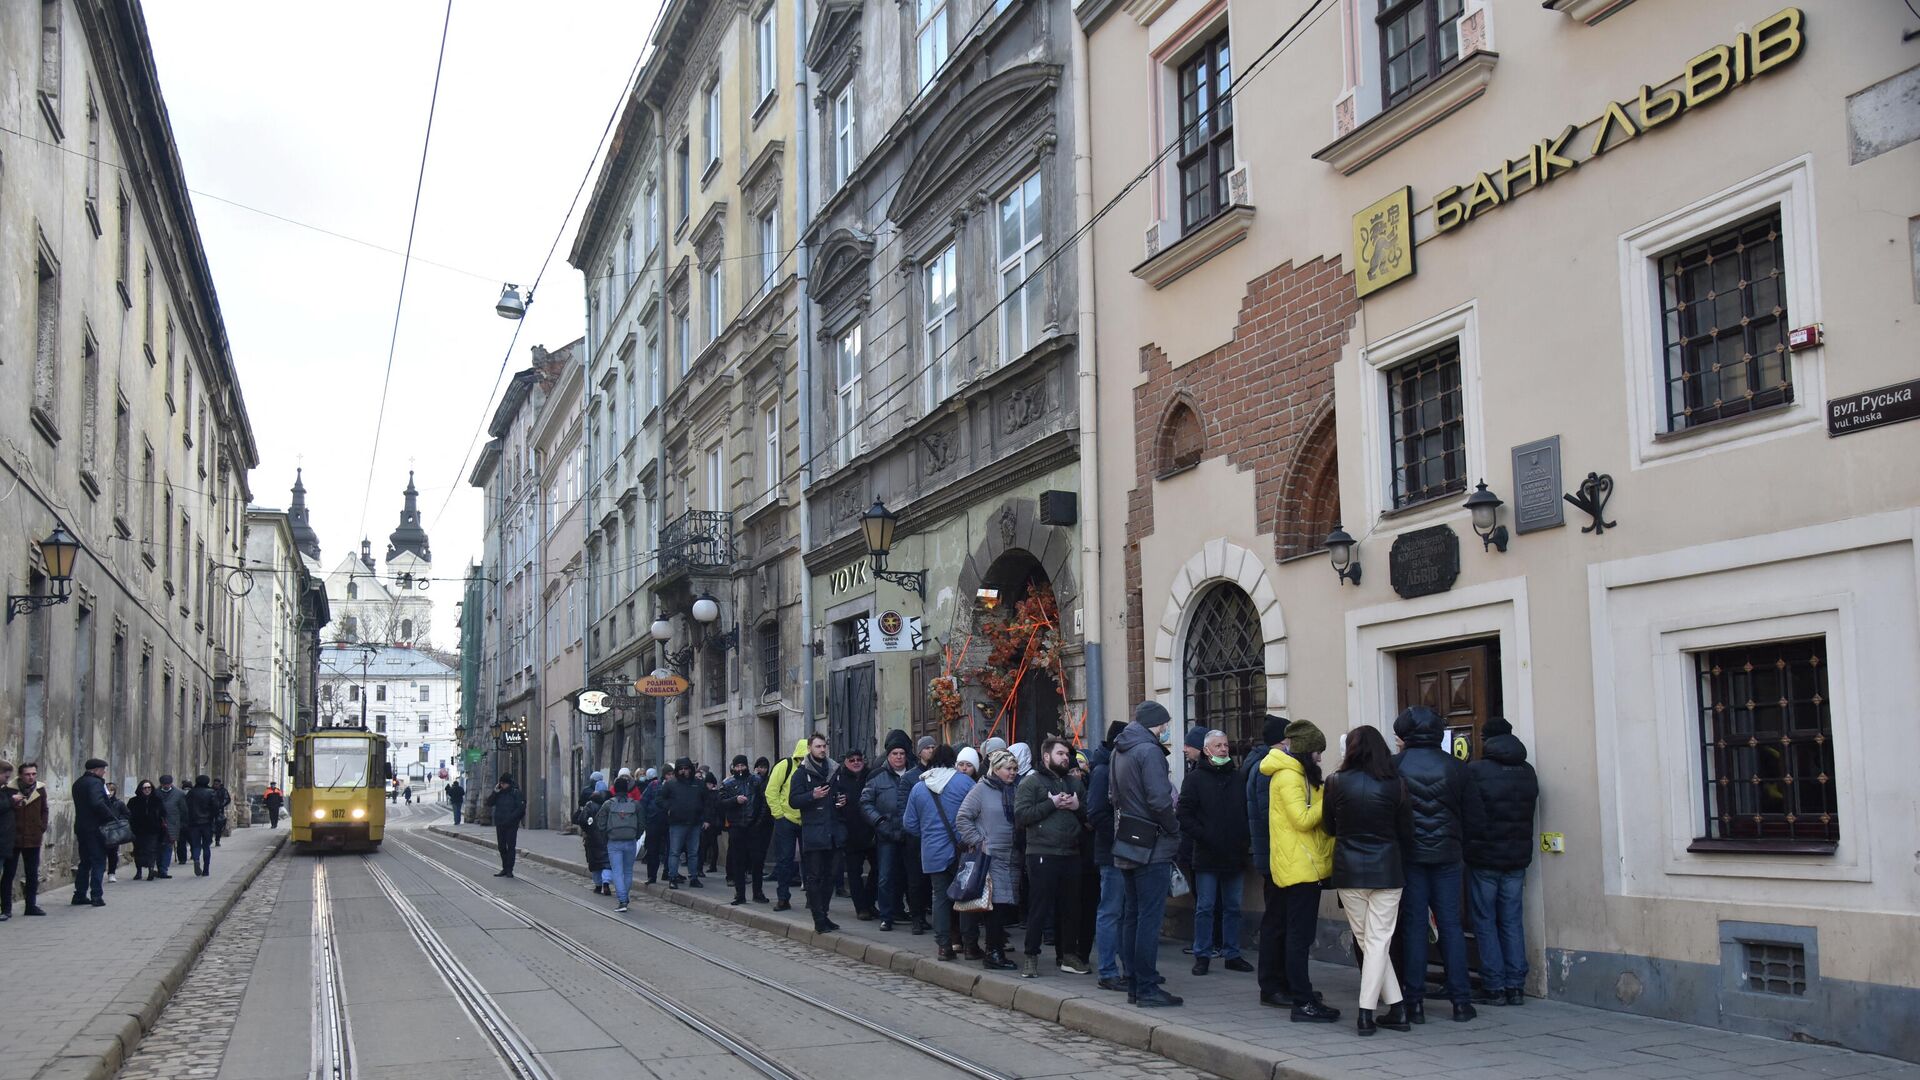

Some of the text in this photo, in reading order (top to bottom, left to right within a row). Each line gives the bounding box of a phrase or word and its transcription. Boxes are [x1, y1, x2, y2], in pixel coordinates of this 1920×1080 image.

[1433, 6, 1806, 233] БАНК ЛЬВІВ
[1861, 388, 1912, 412] Руська
[1834, 411, 1882, 429] vul. Ruska
[1076, 613, 1081, 631] 4
[332, 809, 346, 819] 1072
